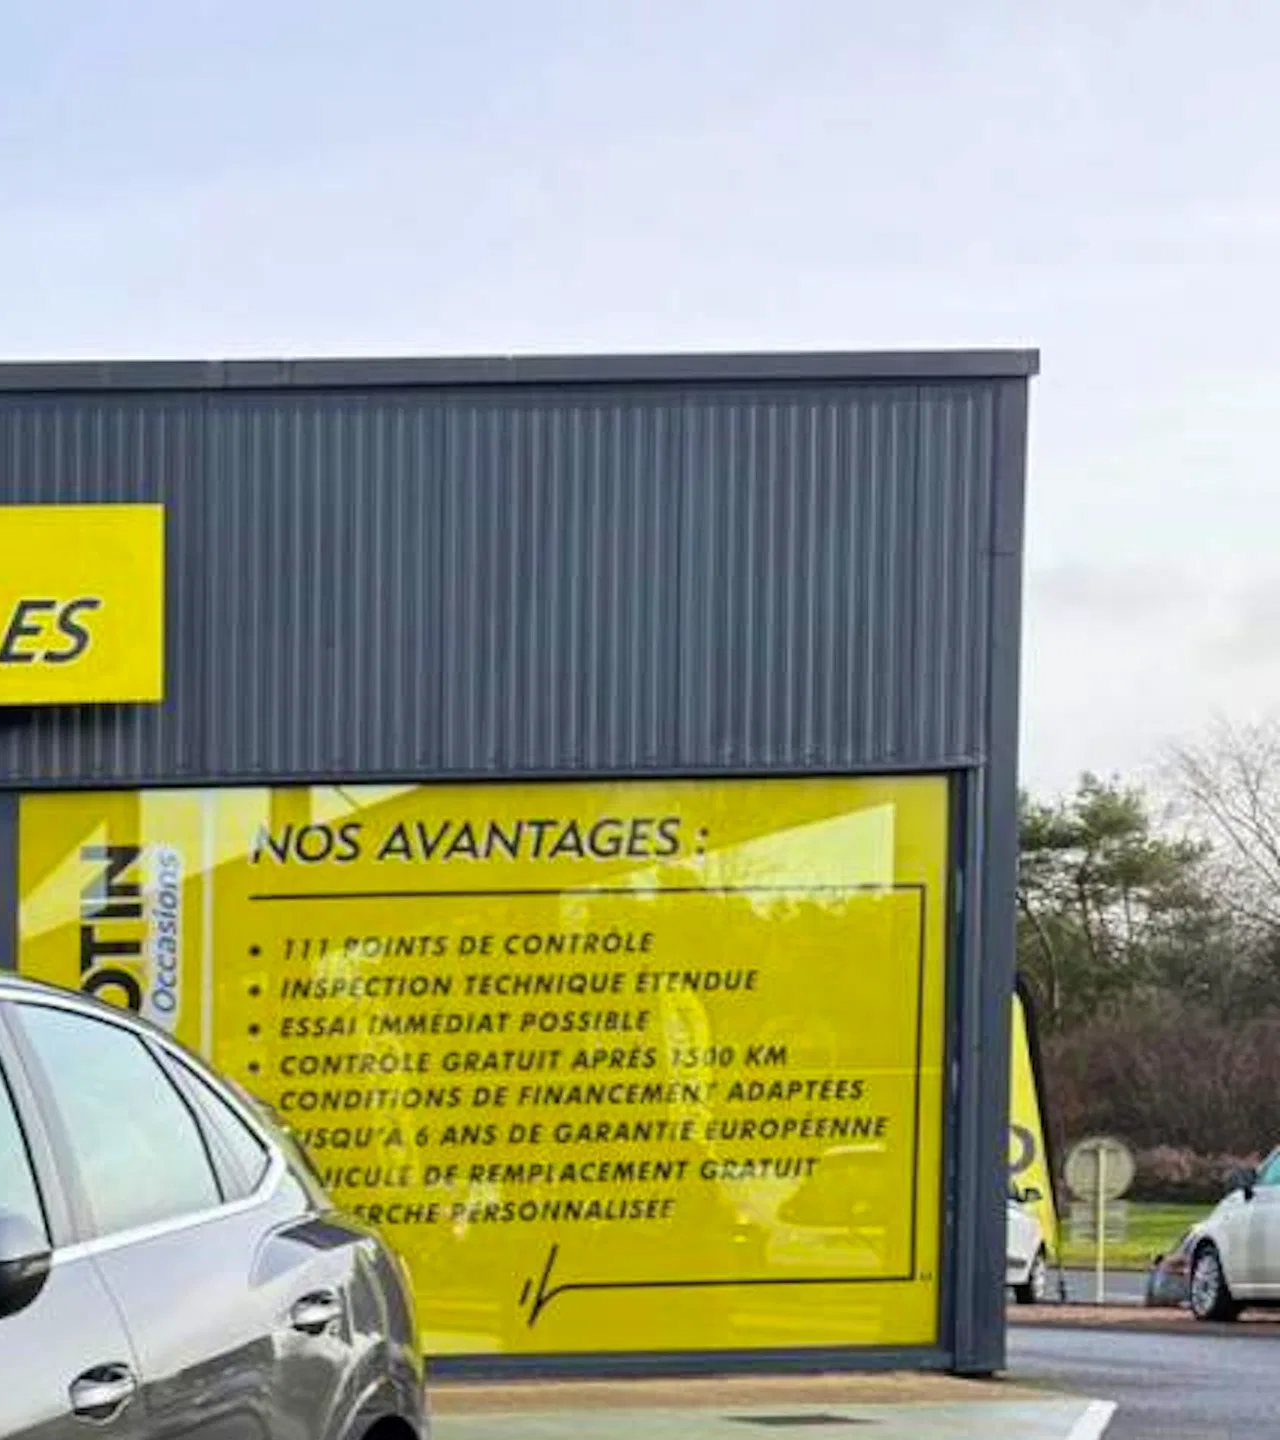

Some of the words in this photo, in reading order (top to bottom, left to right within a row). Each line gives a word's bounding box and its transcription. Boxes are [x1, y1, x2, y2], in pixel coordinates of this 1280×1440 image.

[252, 822, 362, 865] NOS
[377, 818, 681, 862] AVANTAGES
[80, 845, 142, 1011] OTIN
[151, 852, 179, 1014] Occasions
[284, 938, 330, 960] 111
[343, 935, 448, 959] POINTS
[458, 934, 495, 956] DE
[280, 974, 453, 1000] INSPECTION
[464, 971, 626, 996] TECHNIQUE
[280, 1015, 357, 1038] ESSAI
[520, 1009, 652, 1034] POSSIBLE
[442, 1048, 563, 1073] GRATUIT
[744, 1044, 788, 1066] KM
[279, 1085, 462, 1112] CONDITIONS
[471, 1084, 510, 1108] DE
[415, 1126, 429, 1148] 6
[440, 1124, 498, 1147] ANS
[507, 1123, 548, 1146] DE
[553, 1118, 697, 1144] GARANTIE
[423, 1163, 459, 1188] DE
[469, 1159, 690, 1186] REMPLACEMENT
[700, 1155, 821, 1181] GRATUIT
